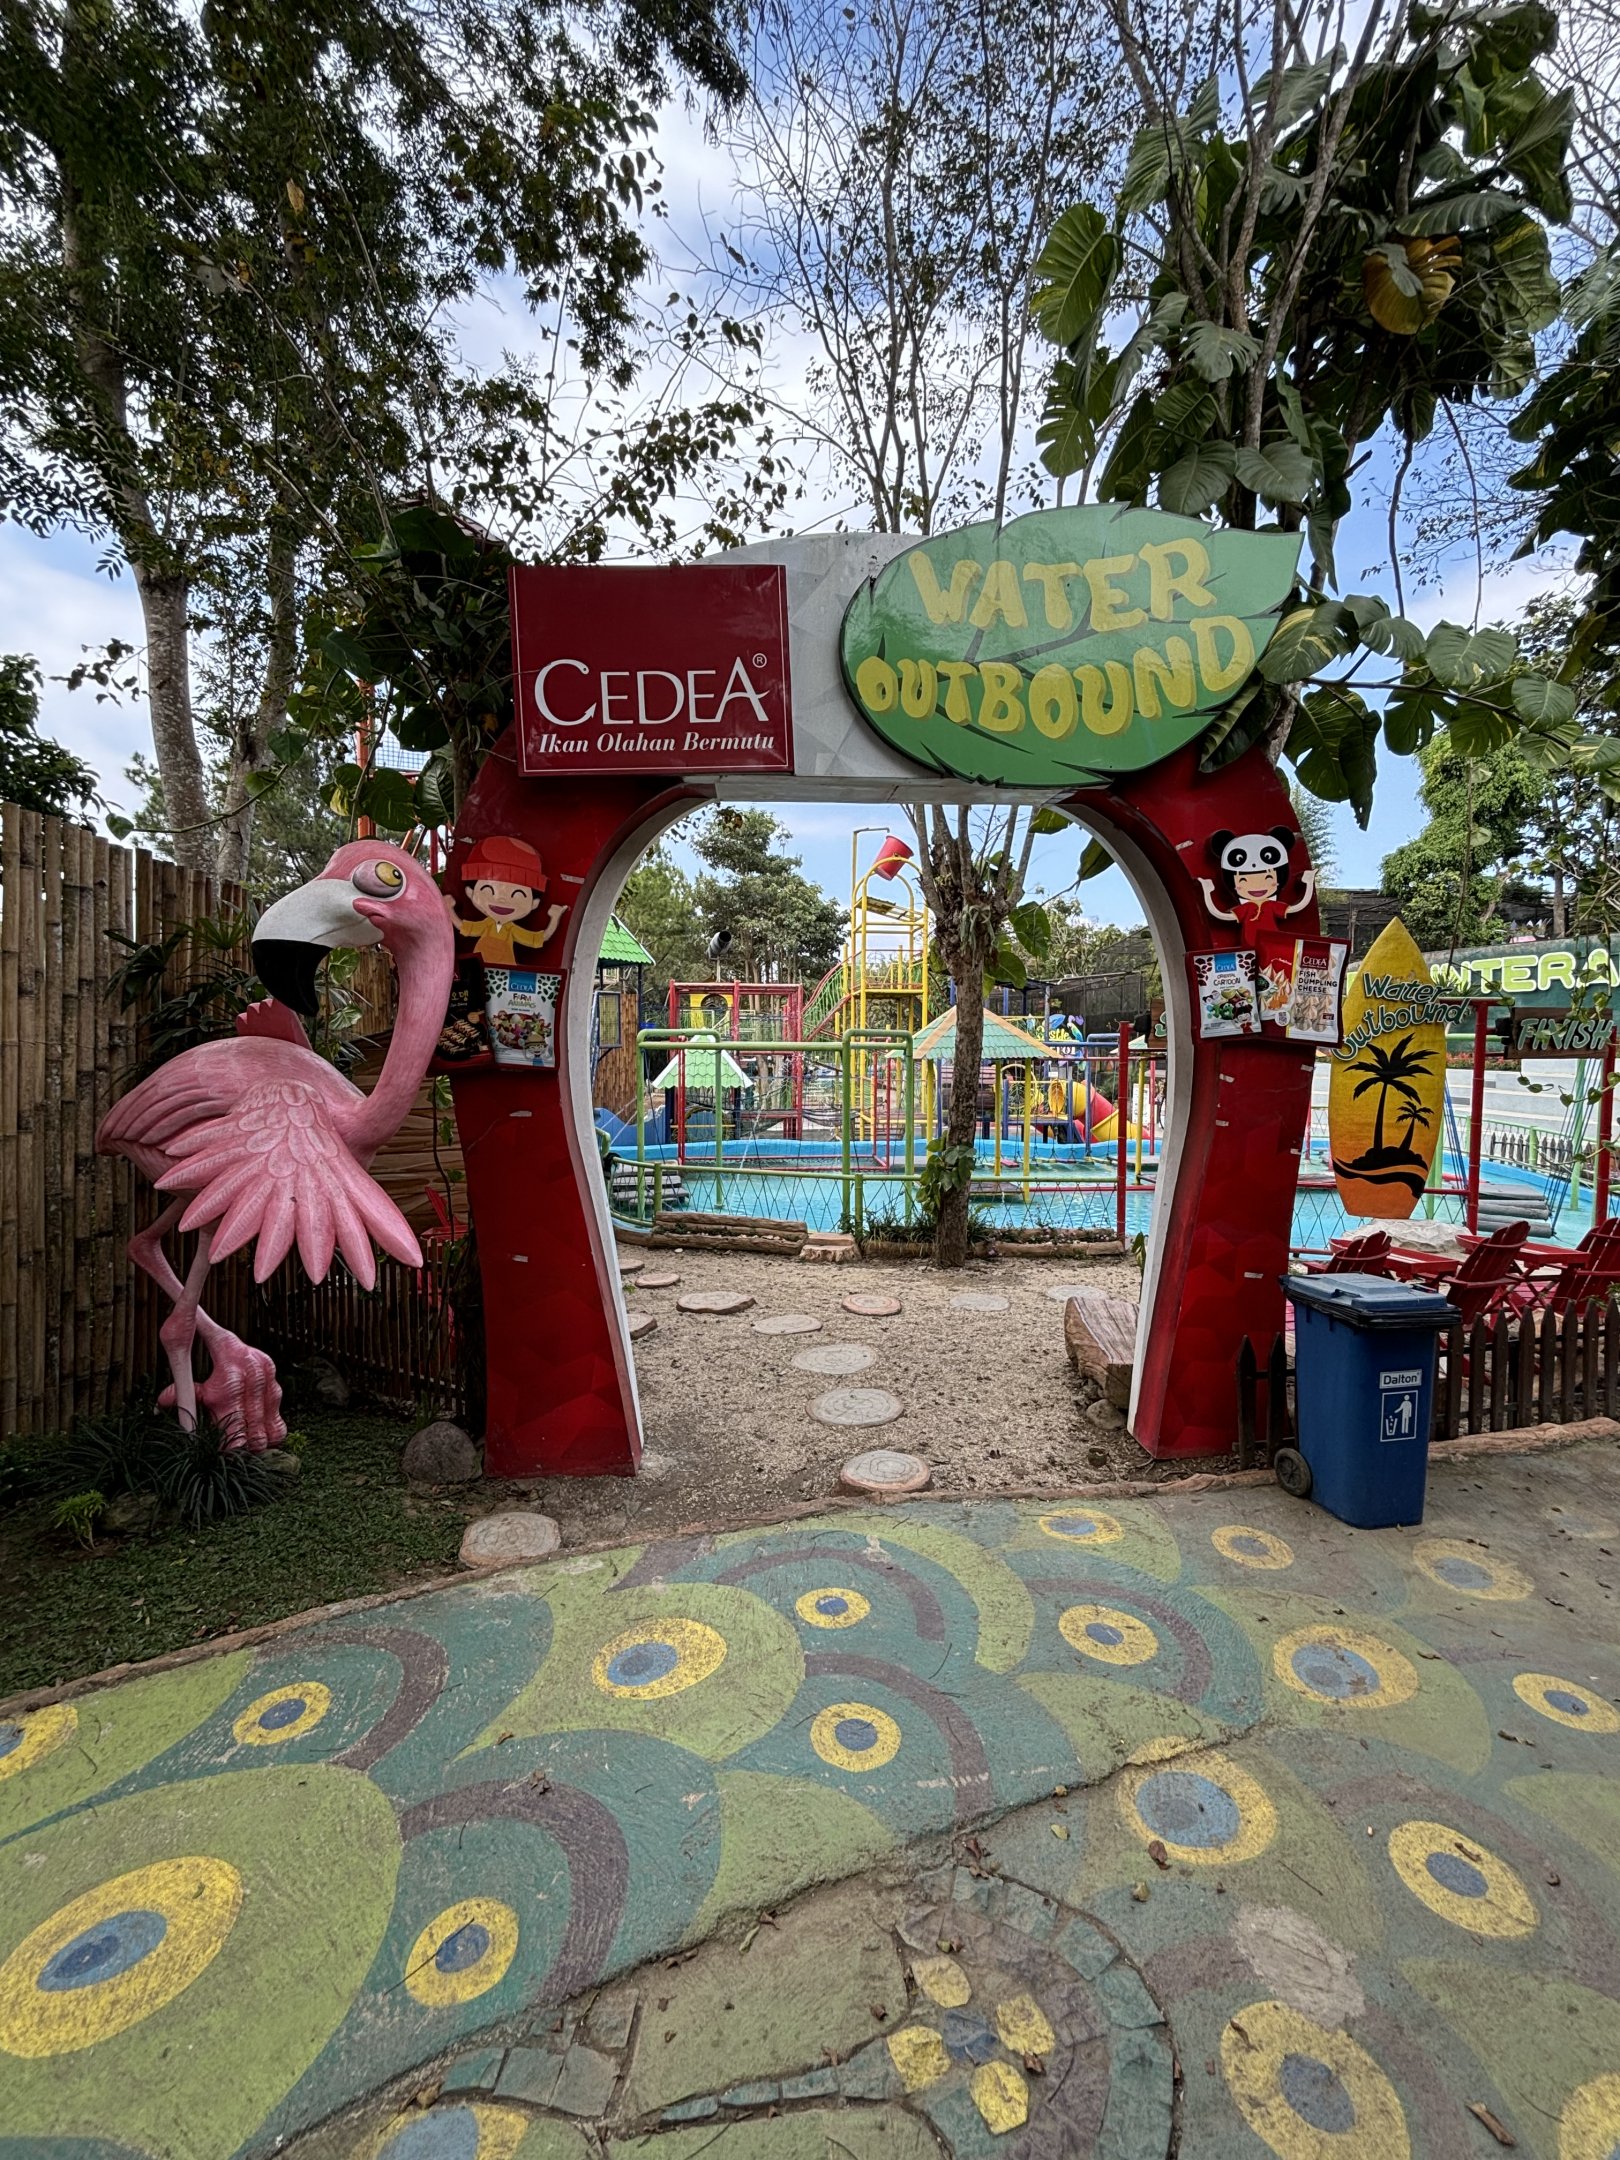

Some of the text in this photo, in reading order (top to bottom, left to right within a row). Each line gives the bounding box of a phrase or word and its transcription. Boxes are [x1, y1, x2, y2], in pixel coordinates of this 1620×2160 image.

[907, 537, 1217, 633] WATER
[856, 614, 1256, 739] OUTBOUND
[539, 731, 774, 753] Ikan Olahan Bermutu
[1299, 970, 1316, 978] FISH
[1213, 977, 1241, 986] CARTOON
[1298, 977, 1338, 988] DUMPLING
[1297, 984, 1327, 993] CHEESE
[1363, 972, 1453, 1004] Water
[1383, 1374, 1418, 1385] Dalton
